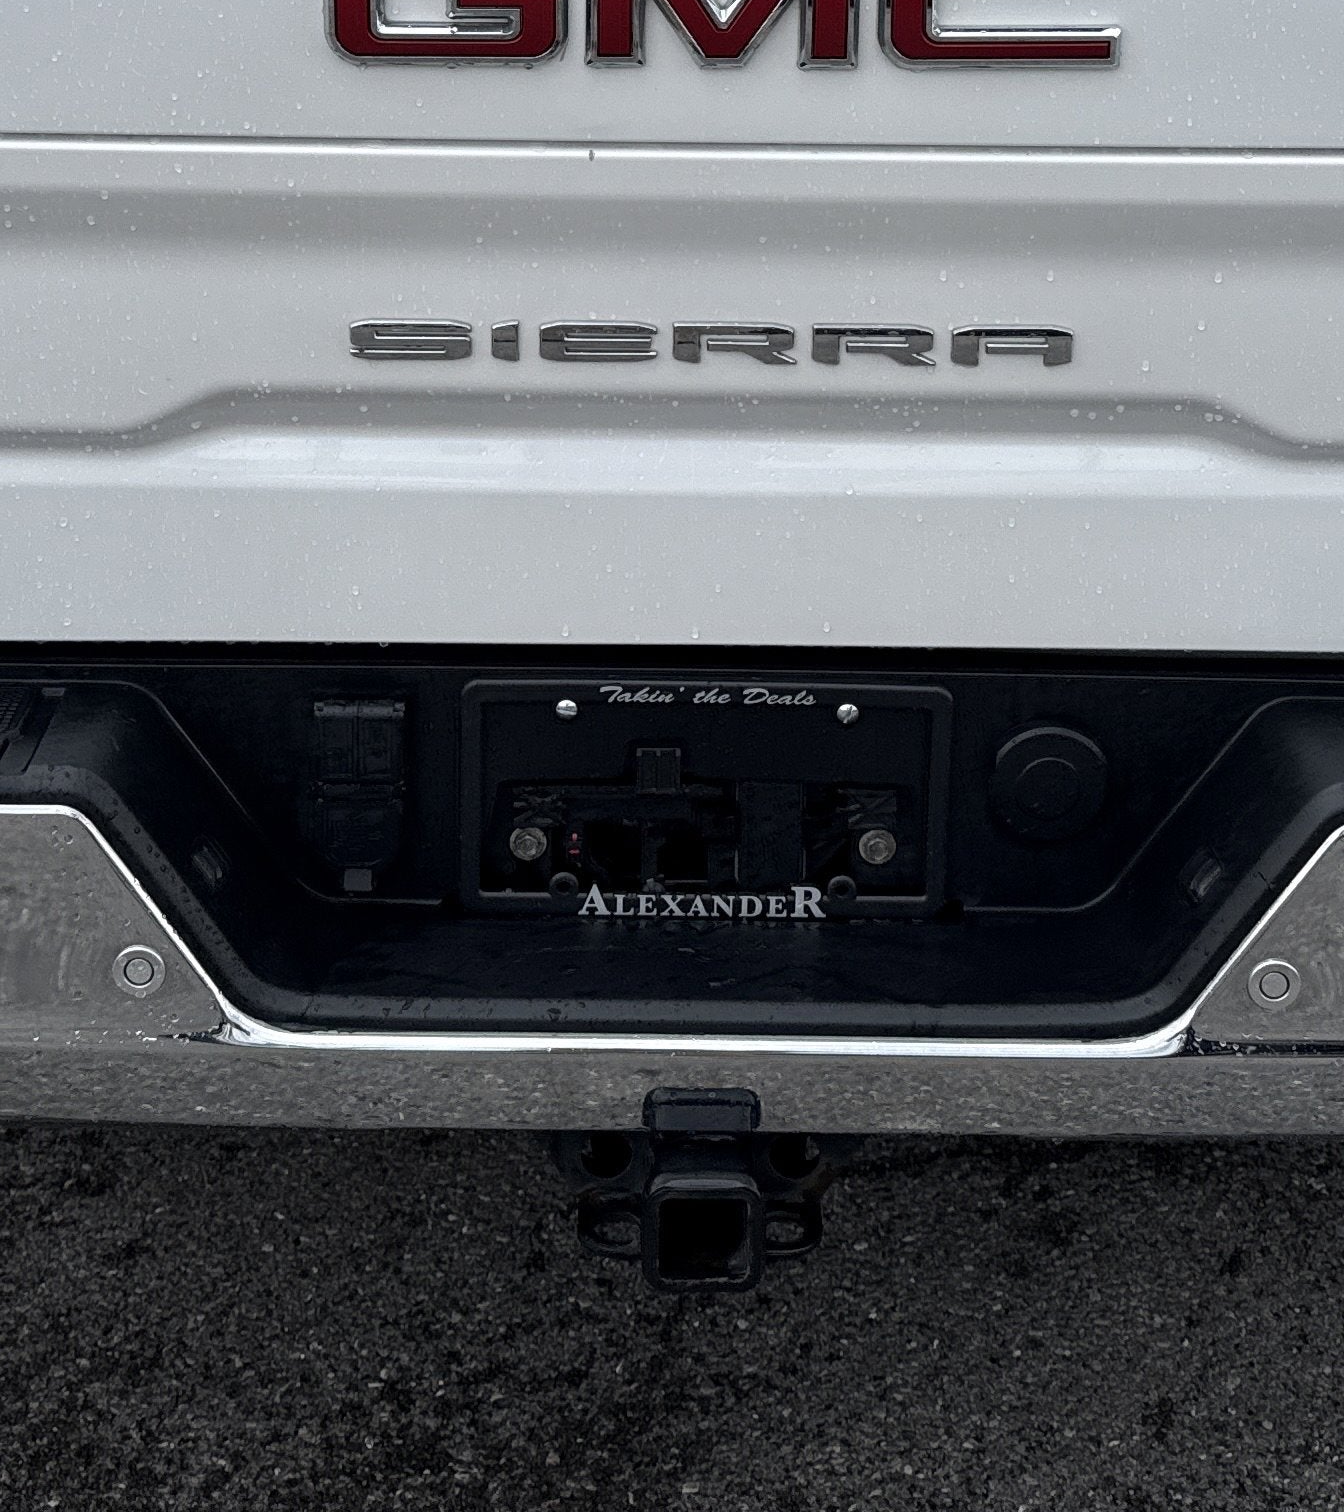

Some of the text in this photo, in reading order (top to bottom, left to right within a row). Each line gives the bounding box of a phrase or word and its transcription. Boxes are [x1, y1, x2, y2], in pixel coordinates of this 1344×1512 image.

[349, 318, 1074, 367] SIERRA
[599, 685, 817, 706] Takin' the Deals
[577, 884, 826, 919] ALEXANDER
